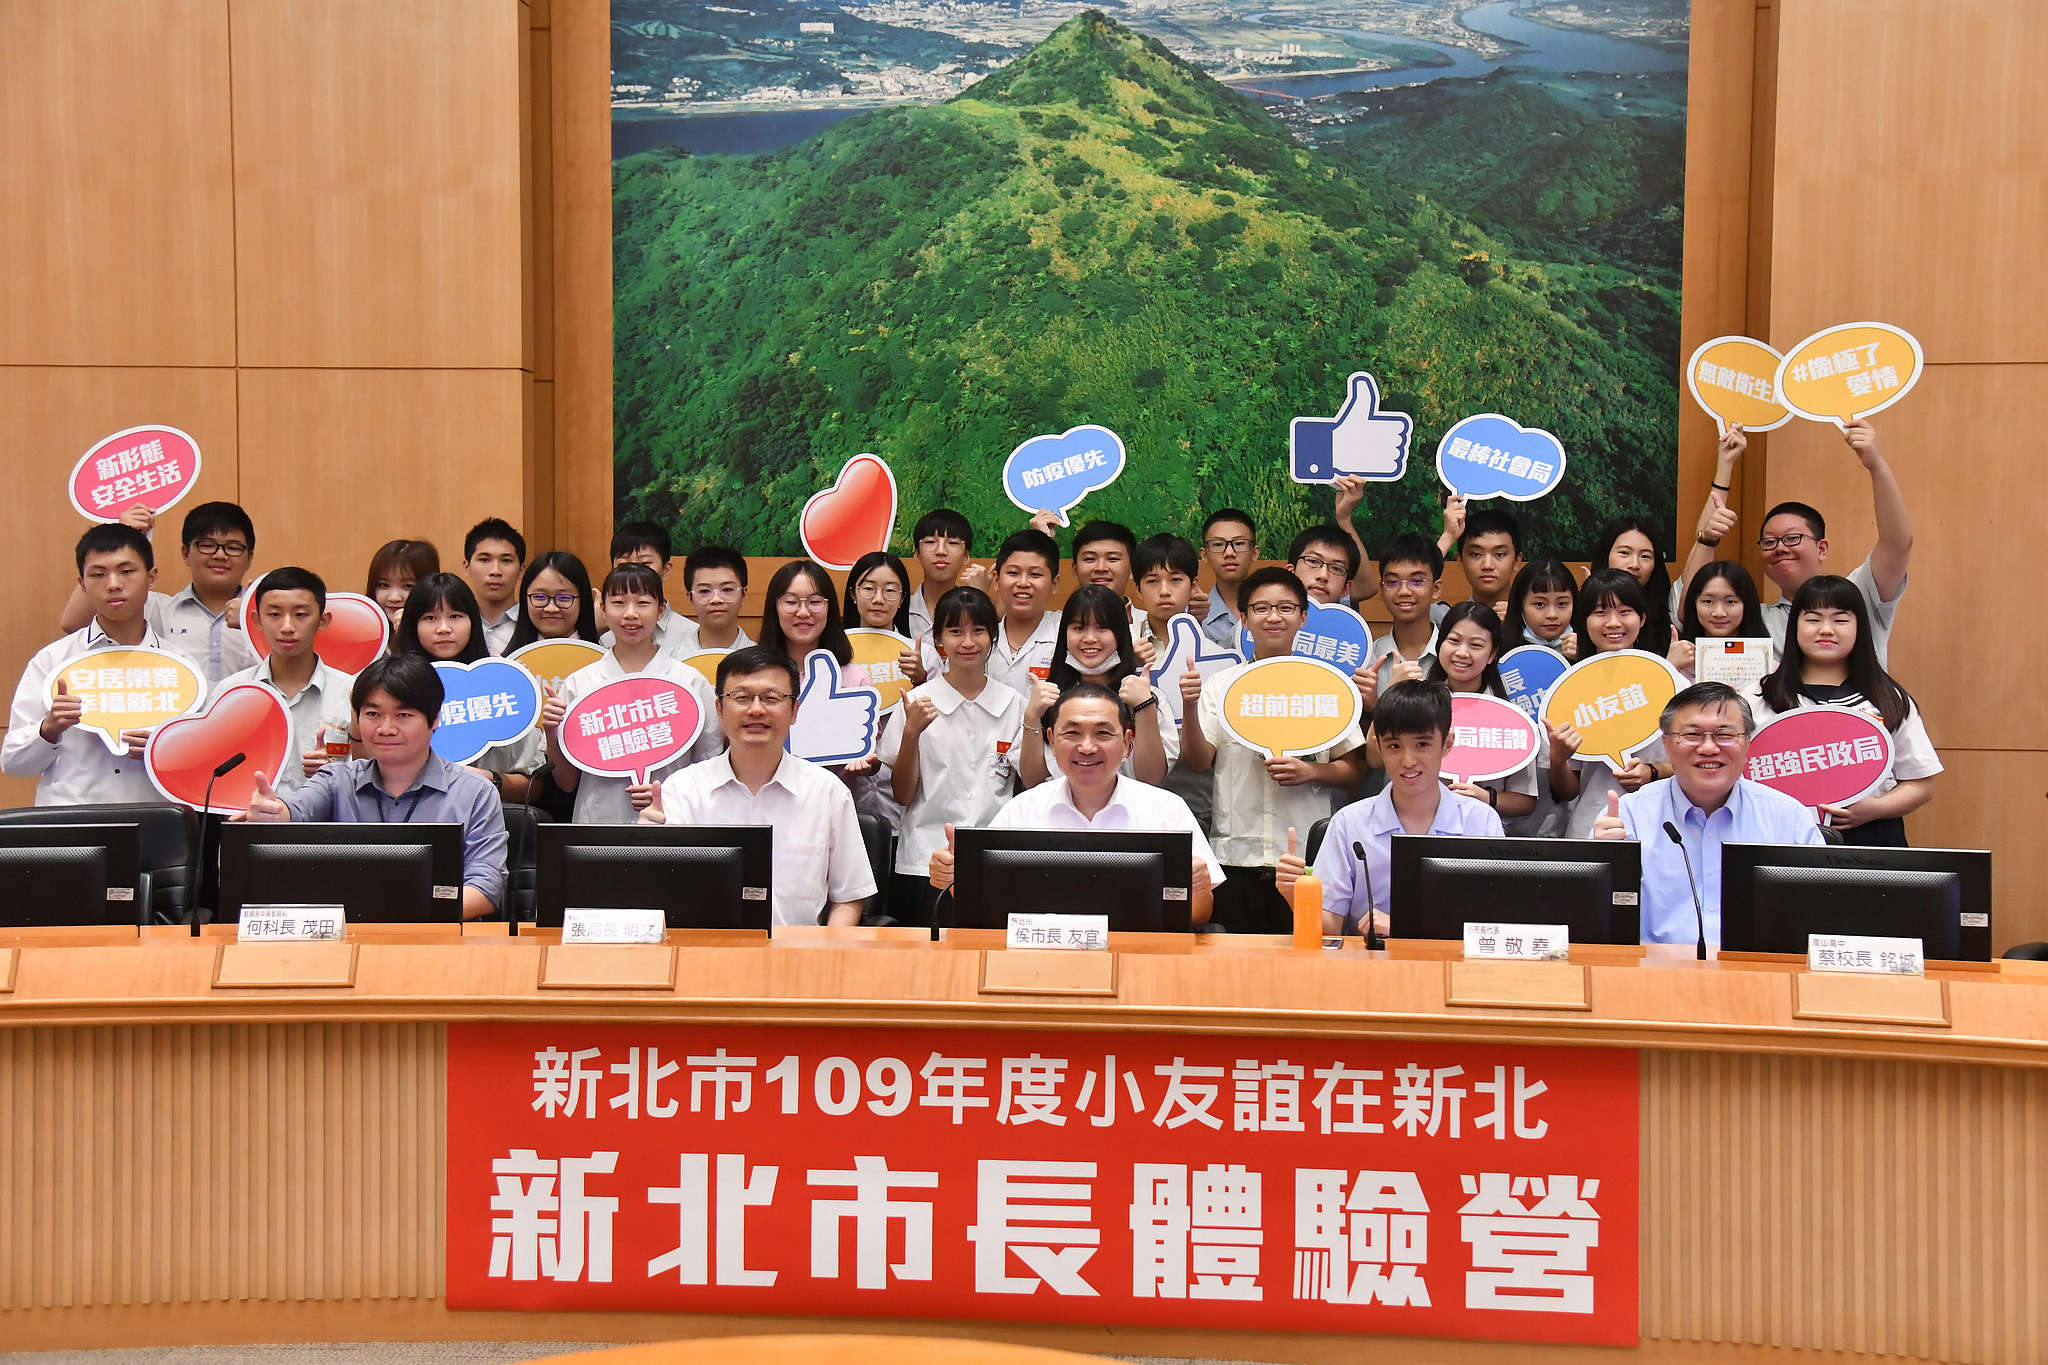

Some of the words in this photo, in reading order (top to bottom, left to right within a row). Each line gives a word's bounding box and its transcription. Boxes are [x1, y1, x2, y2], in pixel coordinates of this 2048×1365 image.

[1698, 360, 1783, 404] 無敵衛生
[1845, 365, 1898, 397] 愛情
[95, 439, 165, 481] 新形態
[1022, 449, 1107, 489] 防疫優先
[91, 459, 182, 510] 安全生活
[68, 667, 178, 690] 安居樂業
[79, 691, 181, 714] 幸福新北
[438, 692, 519, 727] 疫優先
[578, 690, 680, 737] 新北市長
[1573, 684, 1649, 727] 小友誼
[597, 721, 674, 761] 體驗營
[1449, 726, 1528, 750] 局熊讚
[1749, 735, 1883, 781] 超強民政局
[248, 919, 295, 935] 何科長
[301, 919, 334, 935] 茂田
[1016, 928, 1062, 944] 侯市長
[1068, 928, 1099, 945] 友宜
[1818, 949, 1872, 967] 蔡校長
[531, 1046, 1549, 1140] 新北市109年度小友誼在新北
[488, 1149, 1602, 1314] 新北市長體驗營
